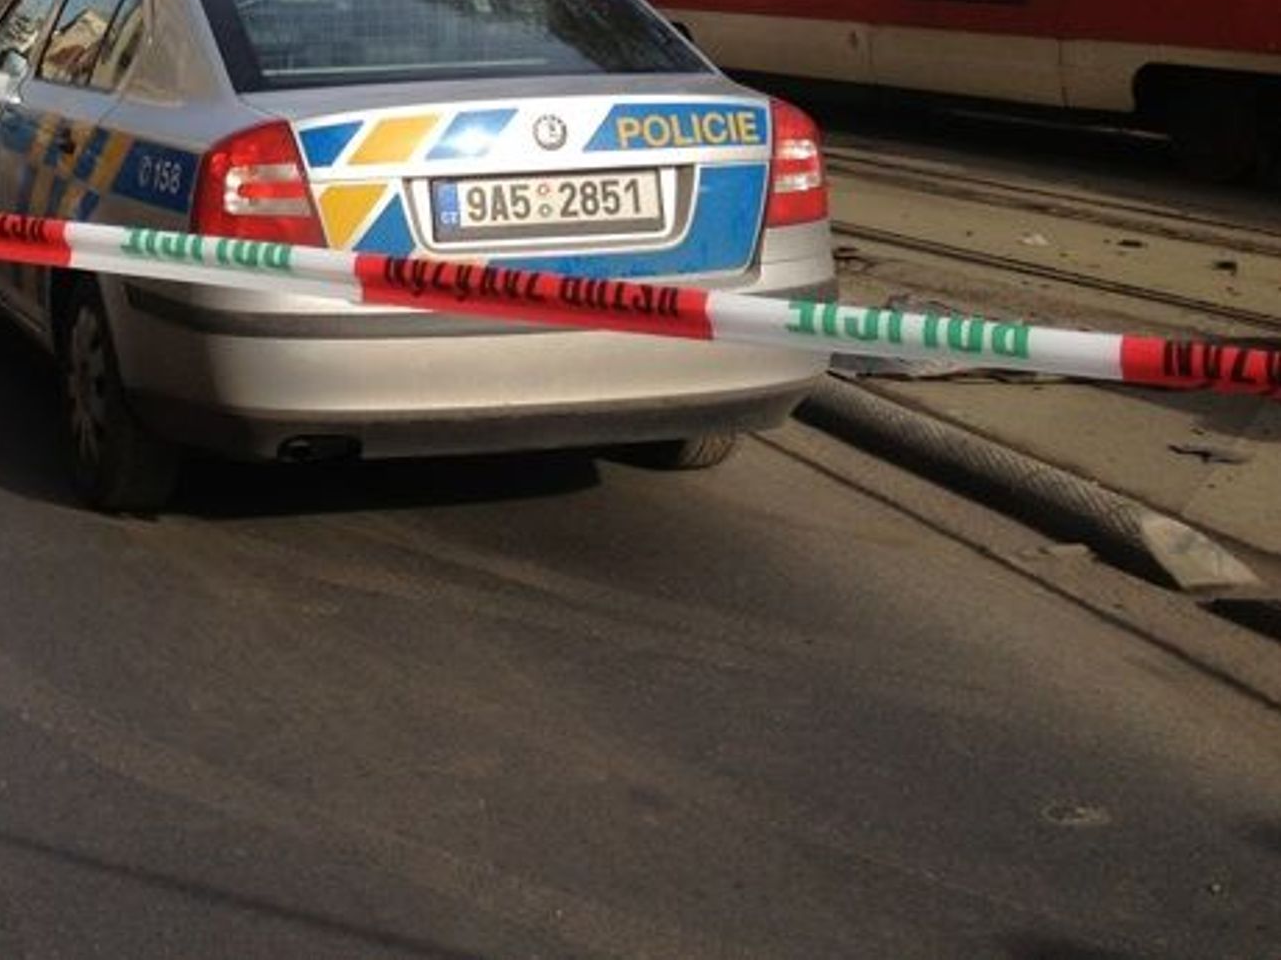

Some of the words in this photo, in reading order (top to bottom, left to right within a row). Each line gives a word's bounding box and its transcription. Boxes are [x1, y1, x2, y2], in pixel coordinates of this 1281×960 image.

[618, 110, 760, 147] POLICIE
[153, 157, 183, 195] 158
[466, 183, 532, 223] 9A5
[558, 177, 643, 219] 2851
